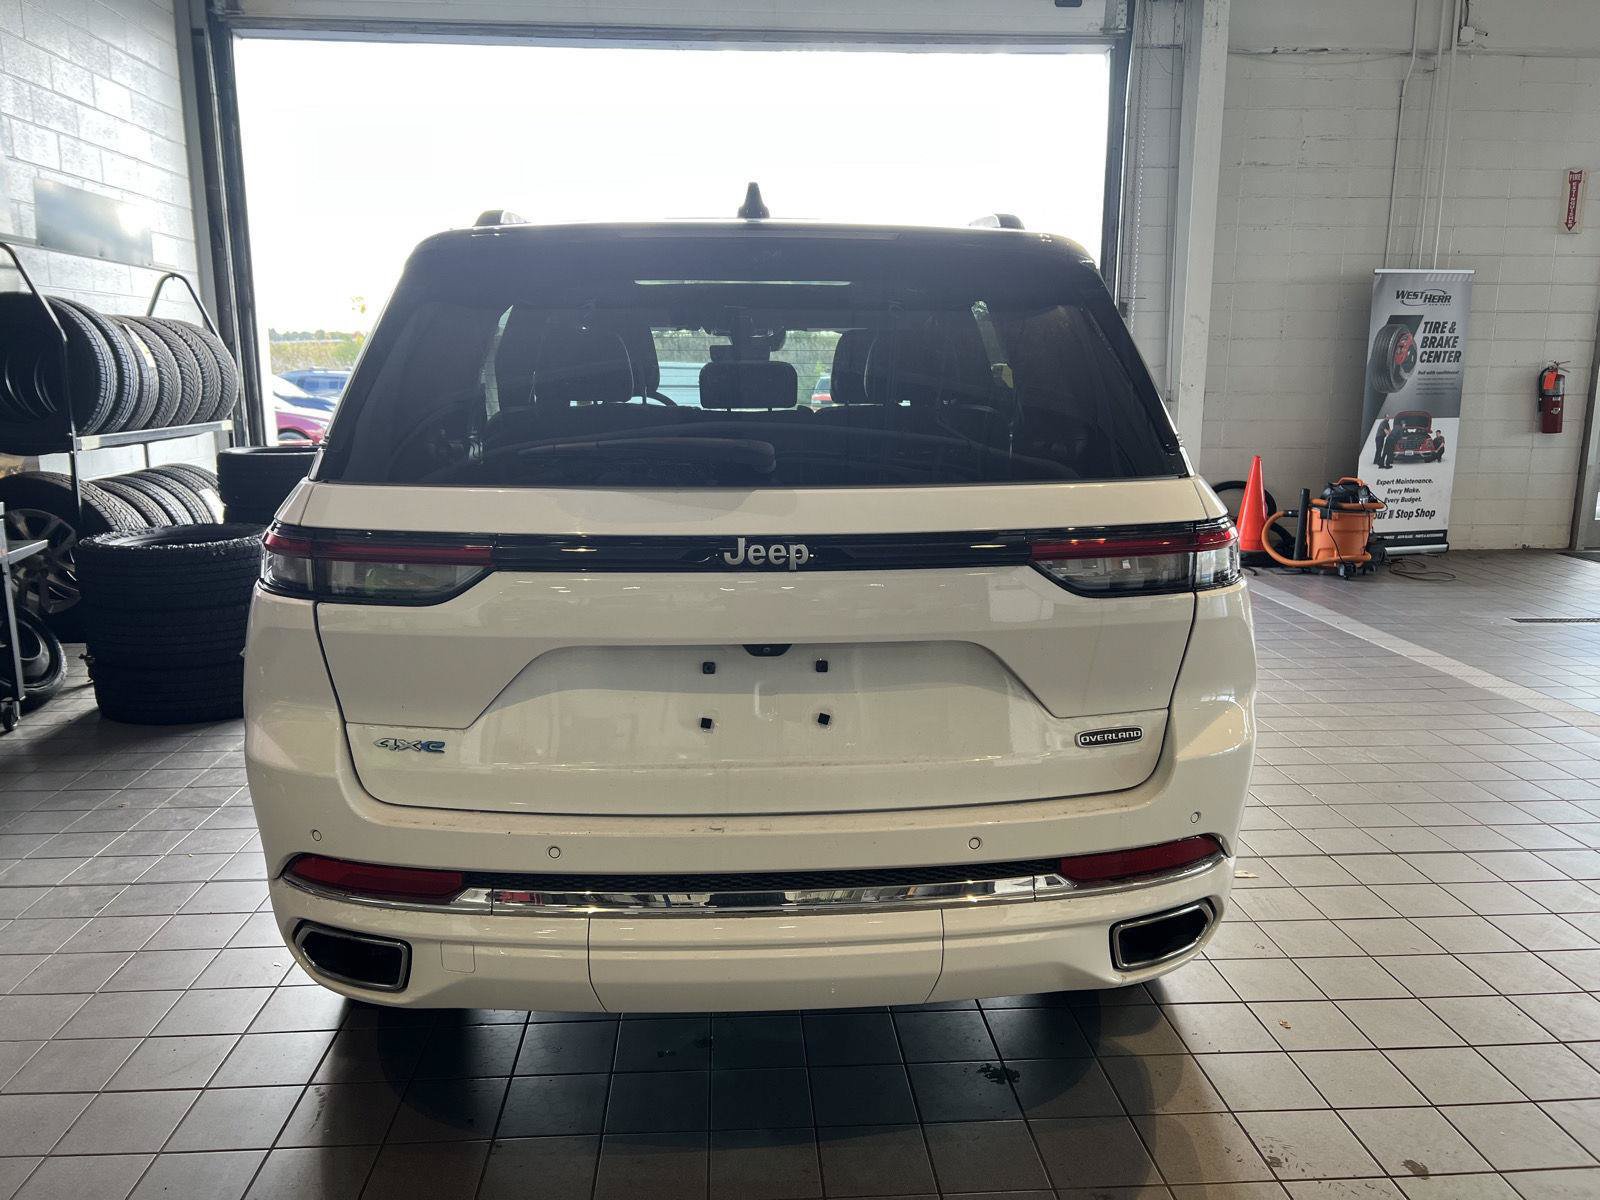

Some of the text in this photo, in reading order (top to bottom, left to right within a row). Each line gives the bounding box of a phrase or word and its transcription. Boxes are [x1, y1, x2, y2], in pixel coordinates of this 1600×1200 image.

[1570, 173, 1581, 181] FIRE
[1568, 182, 1576, 227] EXTINGUISHER
[1396, 290, 1452, 303] WEST HERR
[1422, 321, 1457, 334] TIRE &
[1420, 336, 1459, 348] BRAKE
[1420, 350, 1462, 363] CENTER
[1376, 478, 1395, 486] Expert
[1395, 509, 1414, 520] Stop
[1415, 508, 1436, 519] Shop
[724, 537, 809, 570] Jeep
[1081, 731, 1140, 742] OVERLAND
